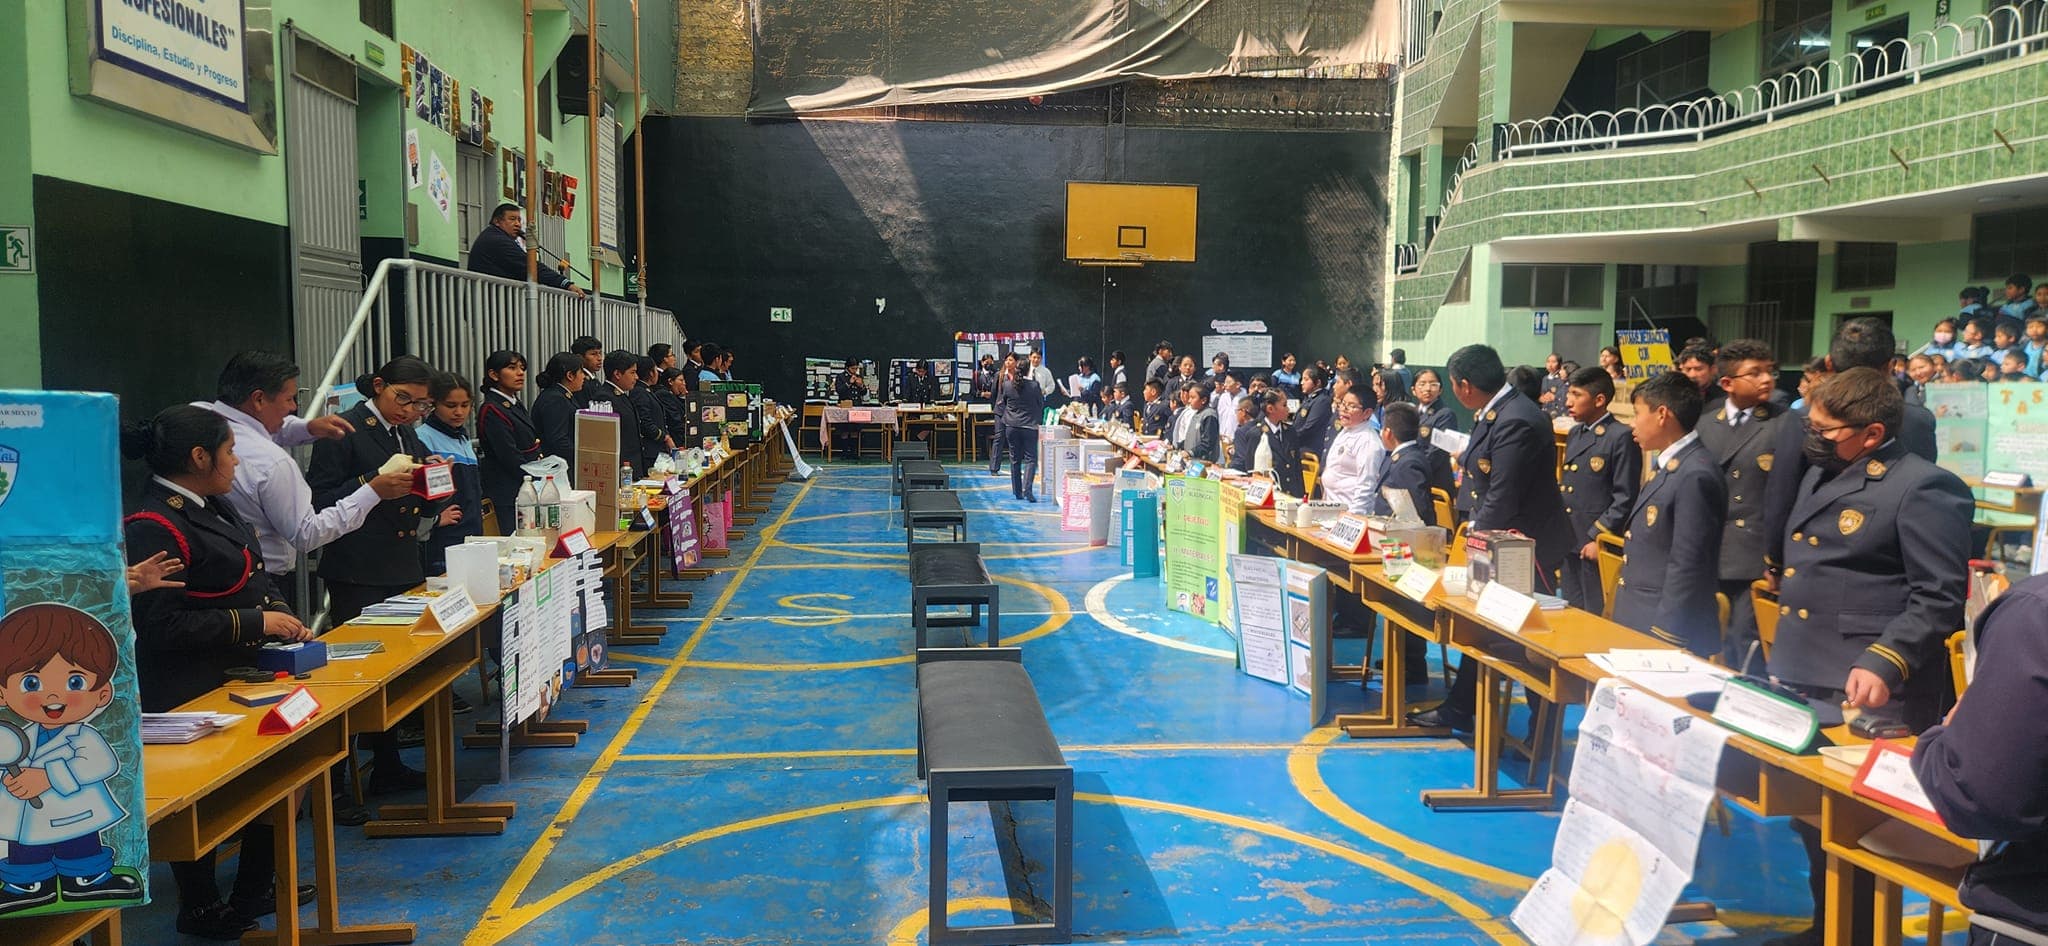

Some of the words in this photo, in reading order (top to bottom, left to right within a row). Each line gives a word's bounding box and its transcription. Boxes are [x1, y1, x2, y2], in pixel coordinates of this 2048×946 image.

[111, 25, 161, 59] Disciplina,
[163, 48, 195, 71] Estudio
[196, 63, 201, 75] y
[203, 65, 238, 88] Progreso
[401, 42, 461, 138] FERIA
[470, 86, 497, 157] DE
